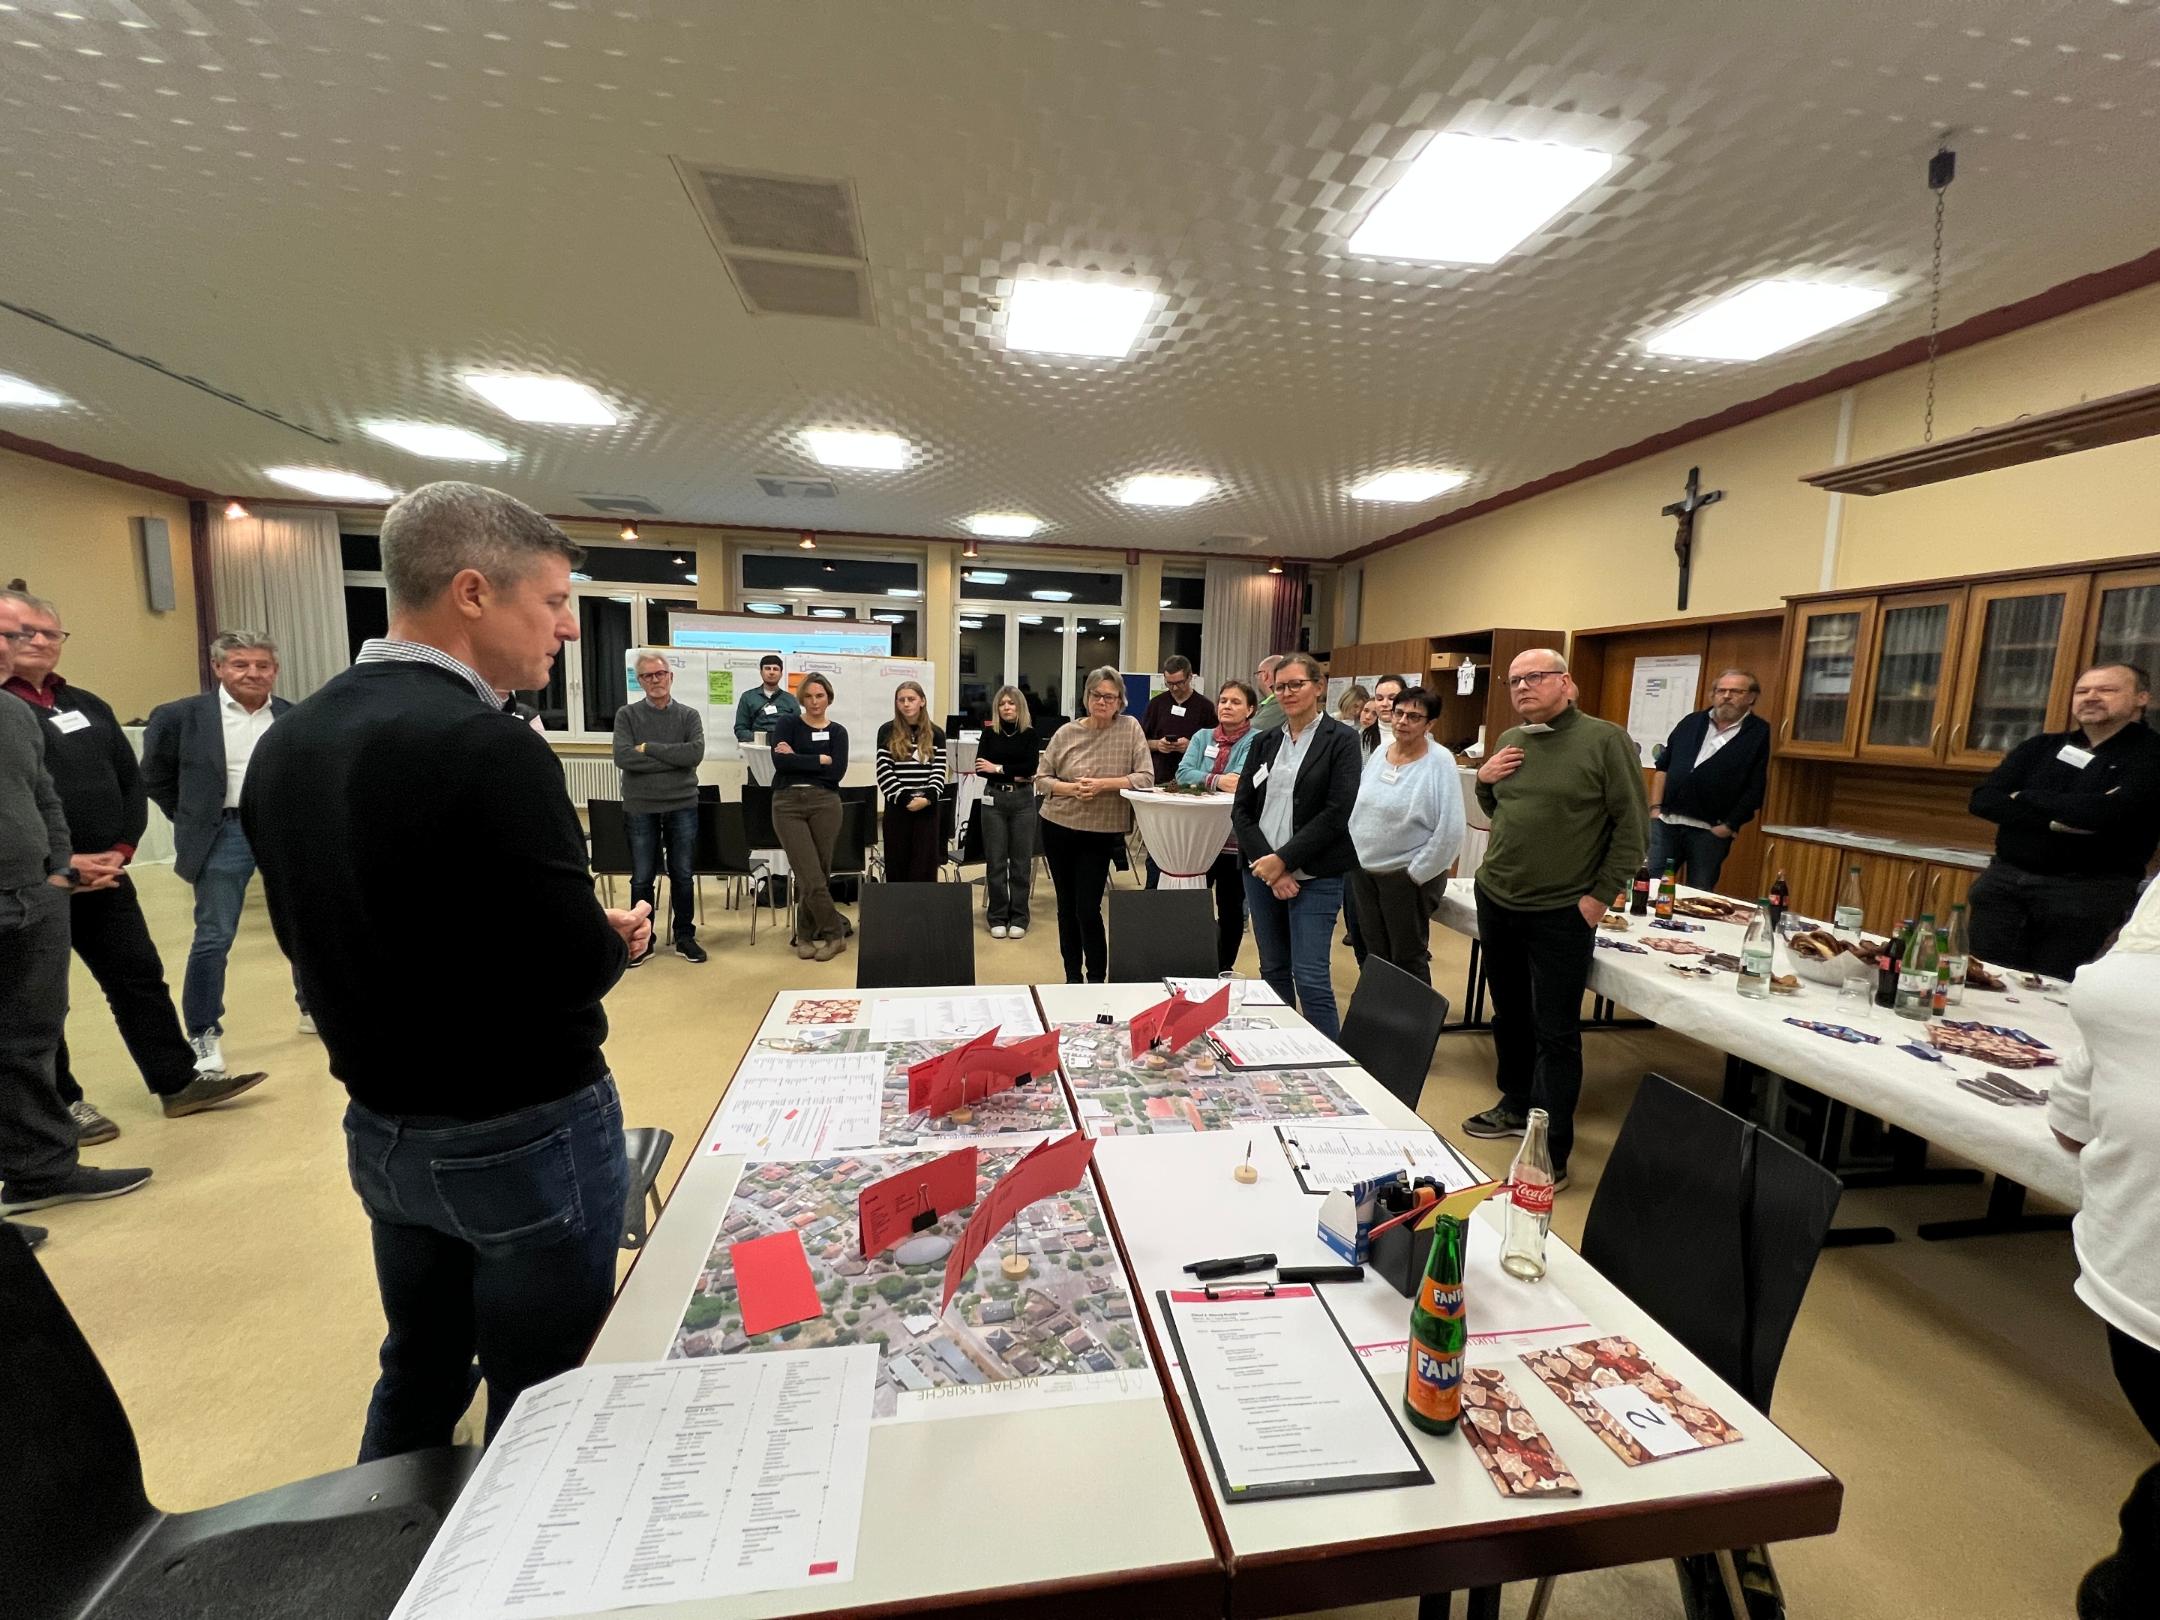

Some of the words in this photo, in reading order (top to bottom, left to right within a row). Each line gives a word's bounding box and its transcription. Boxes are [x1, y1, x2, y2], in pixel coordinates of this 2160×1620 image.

[1417, 1350, 1465, 1381] FANT
[916, 1377, 1040, 1402] MICHAELSKIRCHE
[1626, 1407, 1667, 1430] 2
